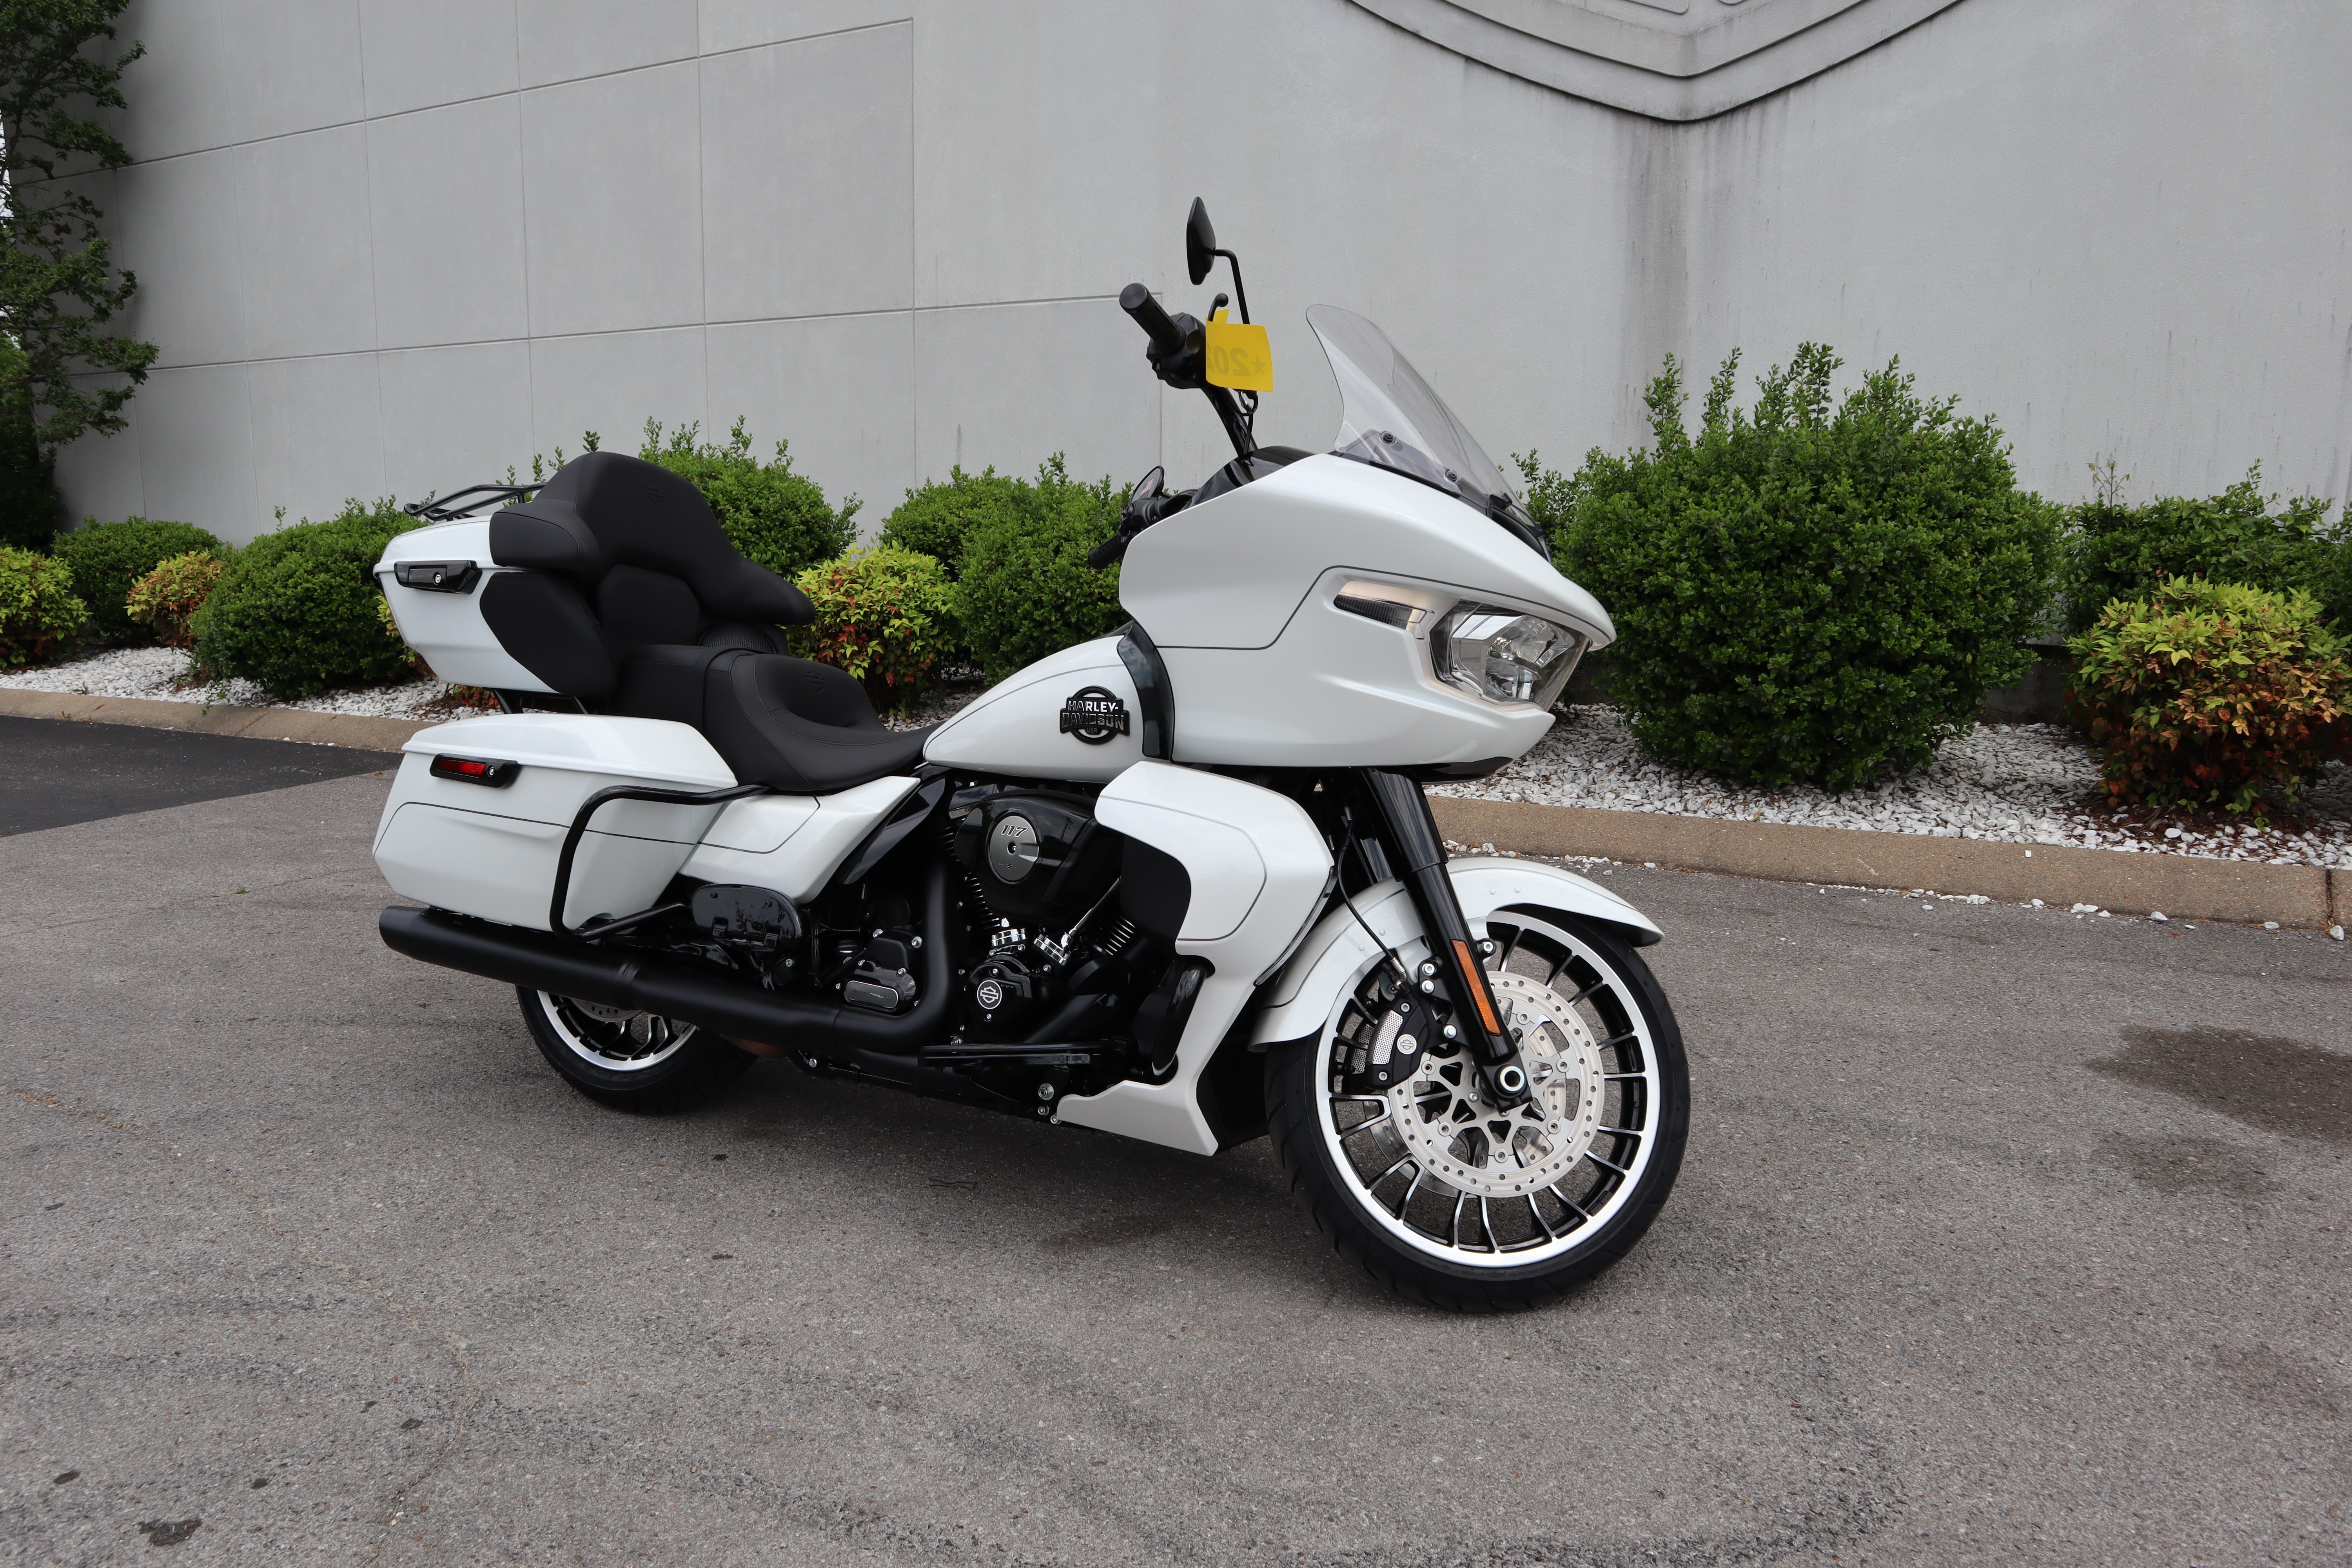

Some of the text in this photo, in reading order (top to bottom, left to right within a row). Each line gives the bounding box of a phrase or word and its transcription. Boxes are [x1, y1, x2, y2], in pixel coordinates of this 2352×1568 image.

[1068, 701, 1119, 712] HARLEY-
[1062, 712, 1124, 731] DAVIDSON
[1000, 825, 1028, 837] 117
